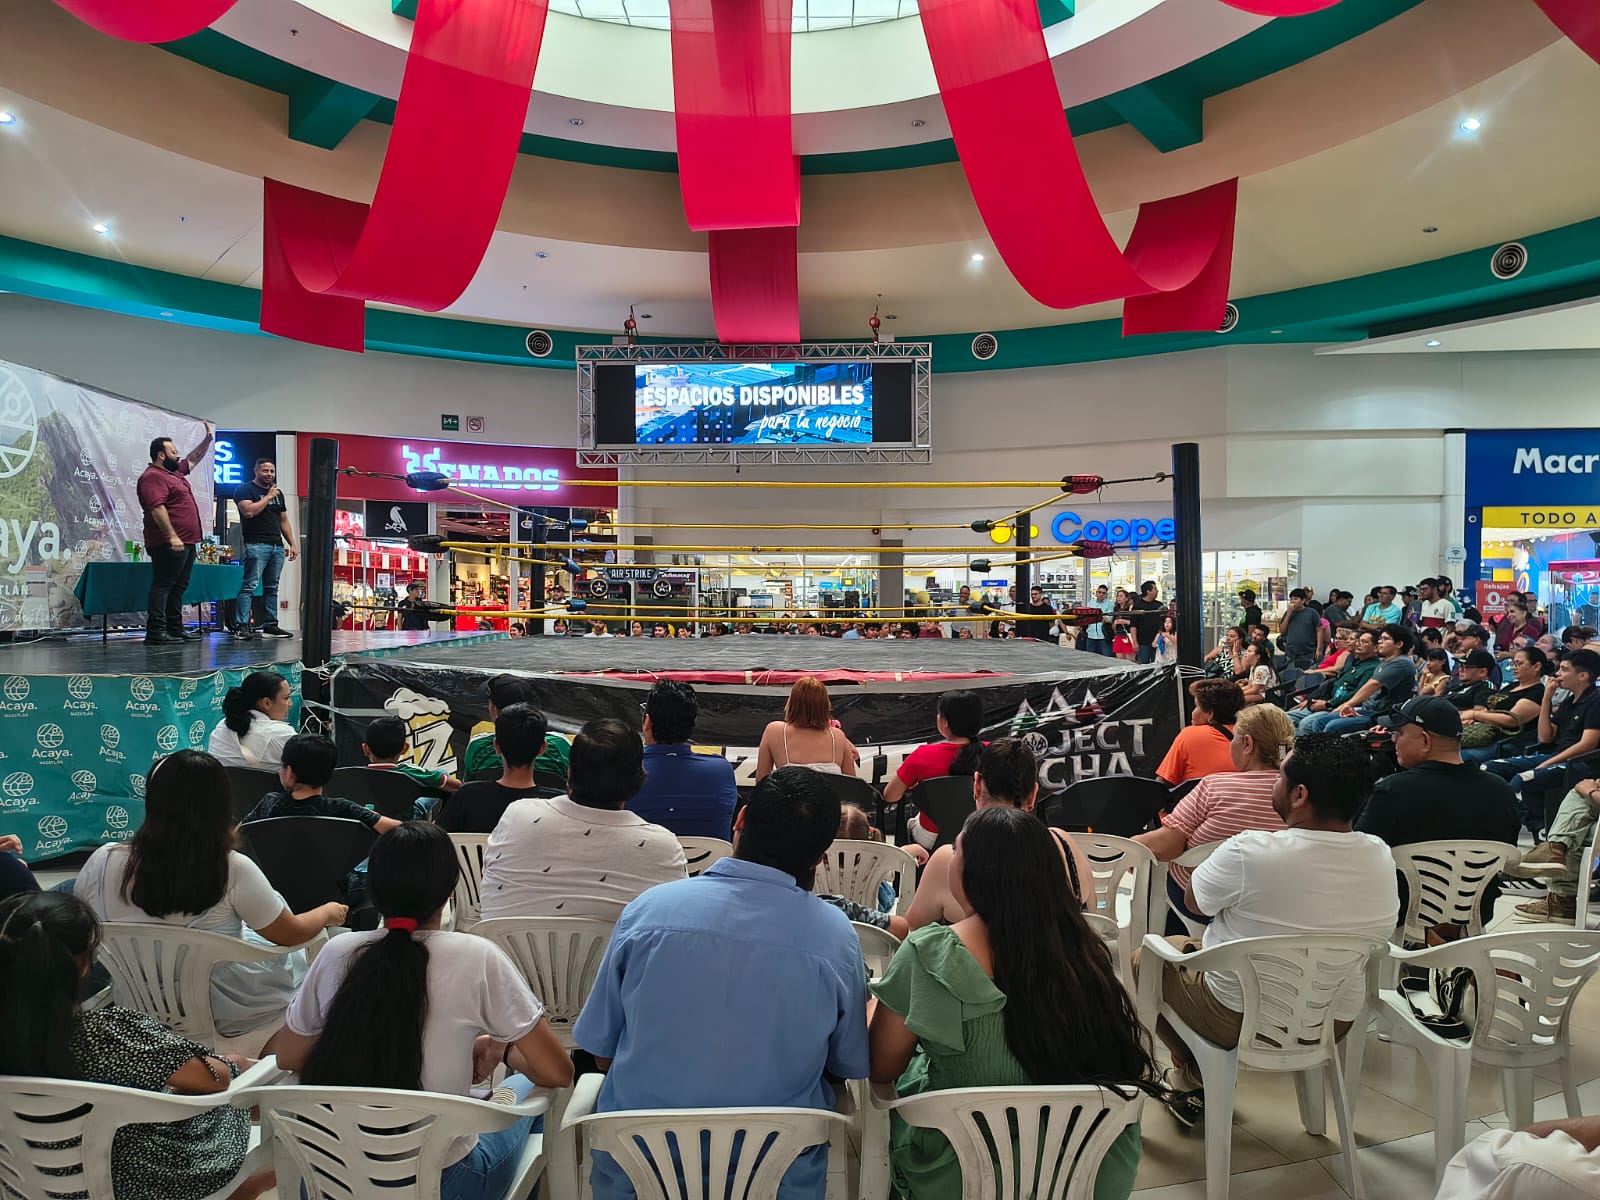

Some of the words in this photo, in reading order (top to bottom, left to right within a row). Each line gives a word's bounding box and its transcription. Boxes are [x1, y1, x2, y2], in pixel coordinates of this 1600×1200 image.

[643, 386, 735, 406] ESPACIOS
[740, 385, 865, 406] DISPONIBLES
[757, 415, 790, 438] para
[797, 409, 810, 430] tu
[815, 409, 861, 438] negocio
[1520, 512, 1576, 524] TODO
[1586, 512, 1597, 524] A
[611, 568, 624, 579] AIR
[625, 568, 652, 579] STRIKE
[0, 700, 38, 713] Acaya.
[63, 699, 98, 711] Acaya.
[125, 700, 160, 713] Acaya.
[32, 748, 73, 760] Acaya.
[35, 837, 73, 851] Acaya.
